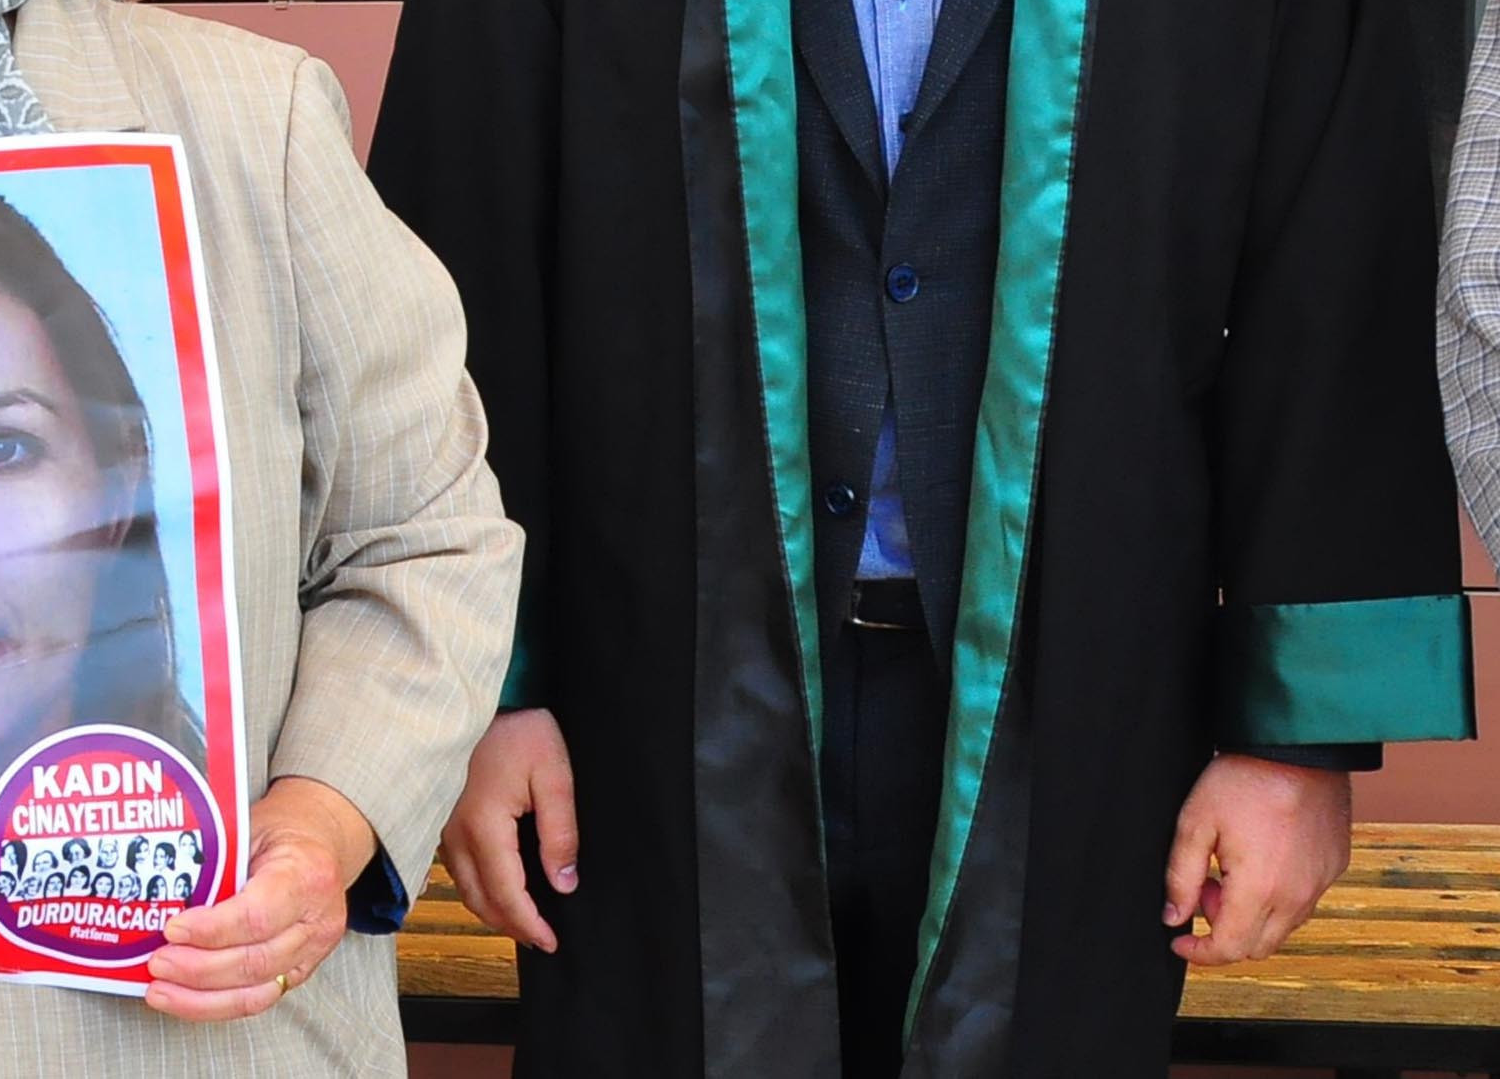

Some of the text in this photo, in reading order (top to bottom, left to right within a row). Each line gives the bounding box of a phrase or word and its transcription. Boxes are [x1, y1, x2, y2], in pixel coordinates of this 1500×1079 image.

[31, 759, 163, 800] KADIN
[11, 791, 185, 836] CİNAYETLERİNİ
[69, 926, 120, 944] Platformu
